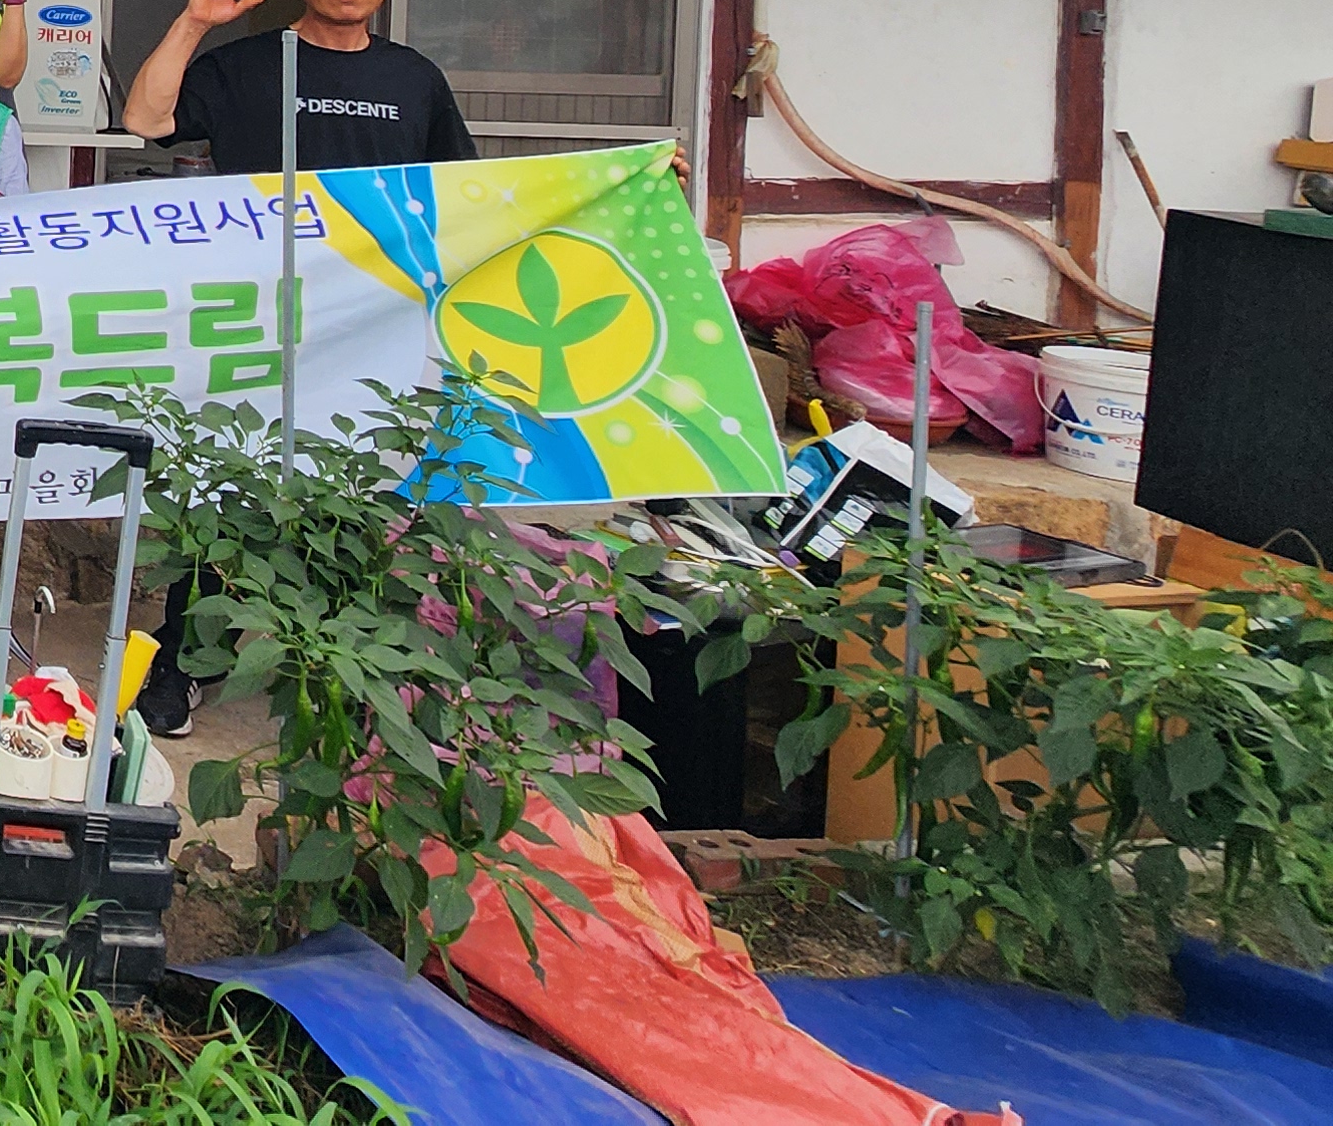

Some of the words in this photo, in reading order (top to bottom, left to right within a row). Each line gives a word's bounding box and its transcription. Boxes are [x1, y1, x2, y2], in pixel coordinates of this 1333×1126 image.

[46, 10, 86, 22] Carrier
[37, 28, 92, 45] 캐리어
[40, 105, 81, 115] Inverter
[308, 98, 401, 121] DESCENTE
